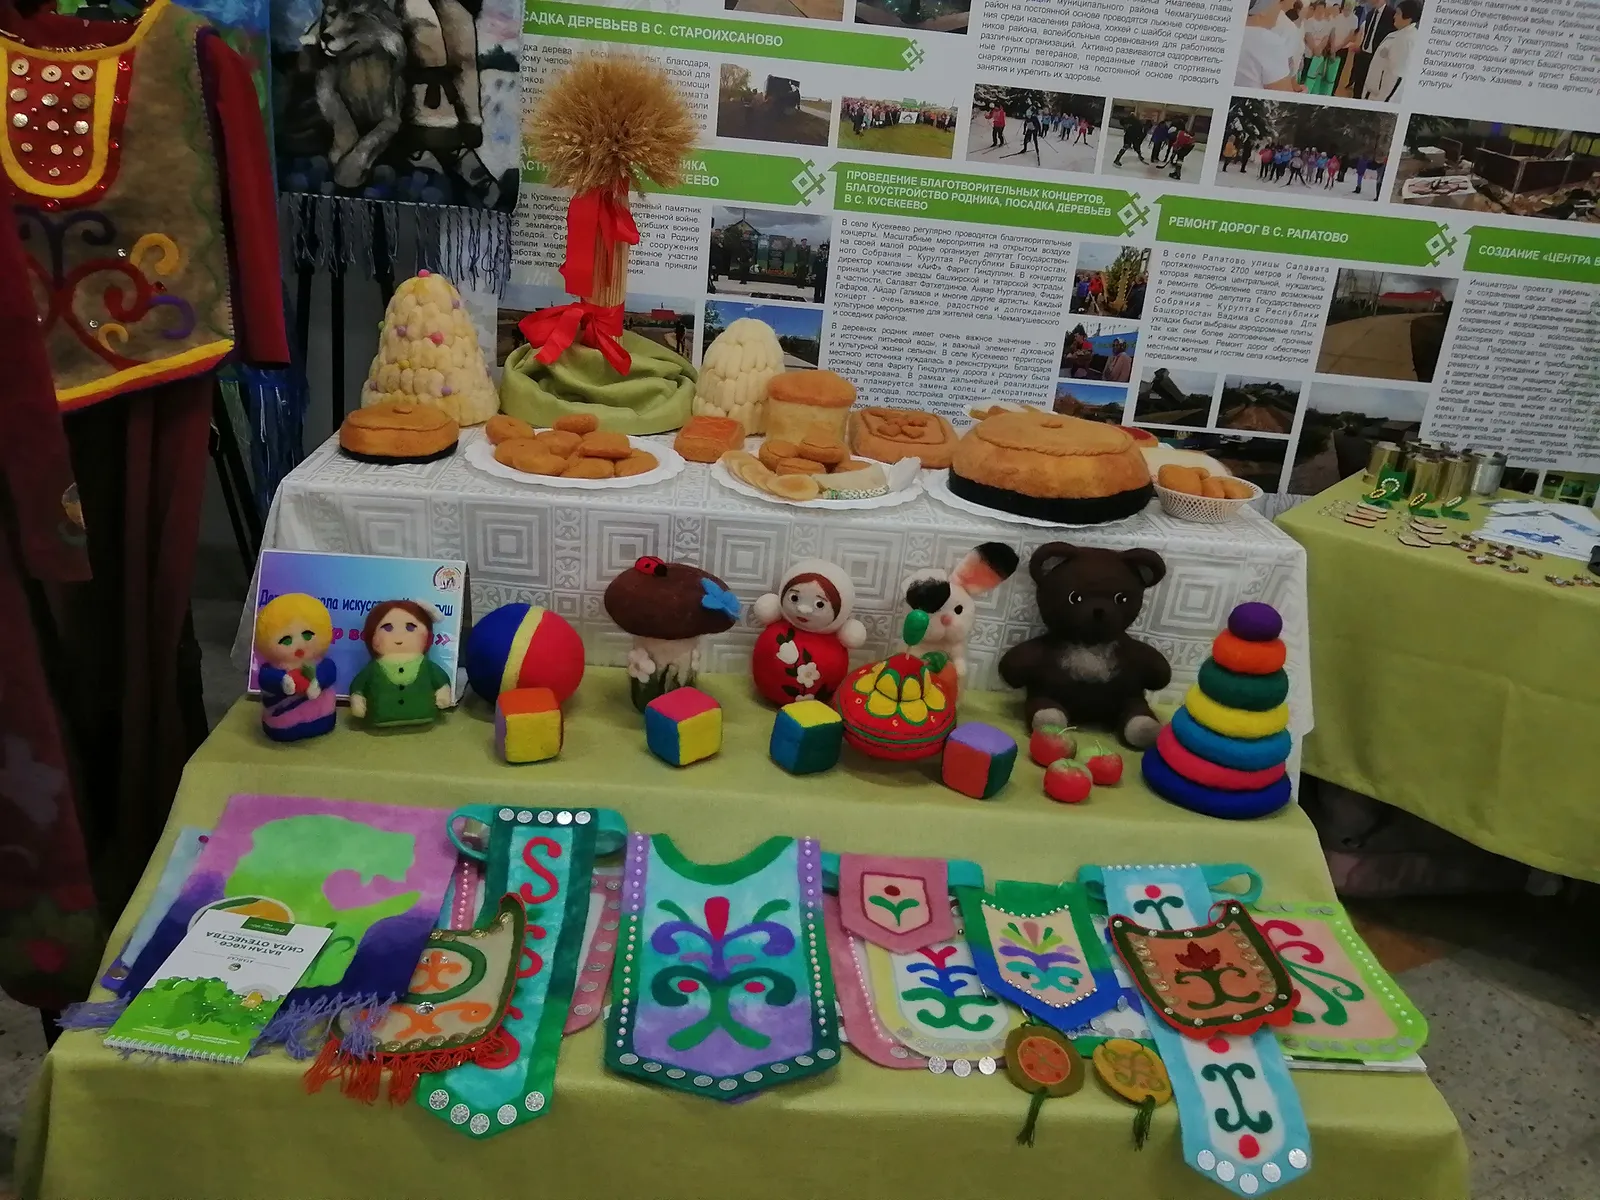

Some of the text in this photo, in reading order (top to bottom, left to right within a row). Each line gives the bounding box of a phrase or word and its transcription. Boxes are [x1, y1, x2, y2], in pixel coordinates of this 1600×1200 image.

[1129, 6, 1160, 16] района
[568, 15, 638, 33] ДЕРЕВЬЕВ
[641, 22, 650, 33] В
[654, 24, 666, 36] С.
[670, 25, 784, 47] СТАРОИХСАНОВО
[845, 182, 1111, 217] БЛАГОУСТРОЙСТВО РОДНИКА, ПОСАДКА ДЕРЕВЬЕВ
[846, 170, 1106, 206] ПРОВЕДЕНИЕ БЛАГОТВОРИТЕЛЬНЫХ КОНЦЕРТОВ,
[844, 194, 928, 211] В С. КУСЕКЕЕВО
[1168, 216, 1349, 244] РЕМОНТ ДОРОГ В С. РАПАТОВО
[1478, 245, 1541, 261] СОЗДАНИЕ
[1542, 252, 1591, 265] «ЦЕНТРА
[206, 931, 304, 953] СИЛА ОТЕЧЕСТВА
